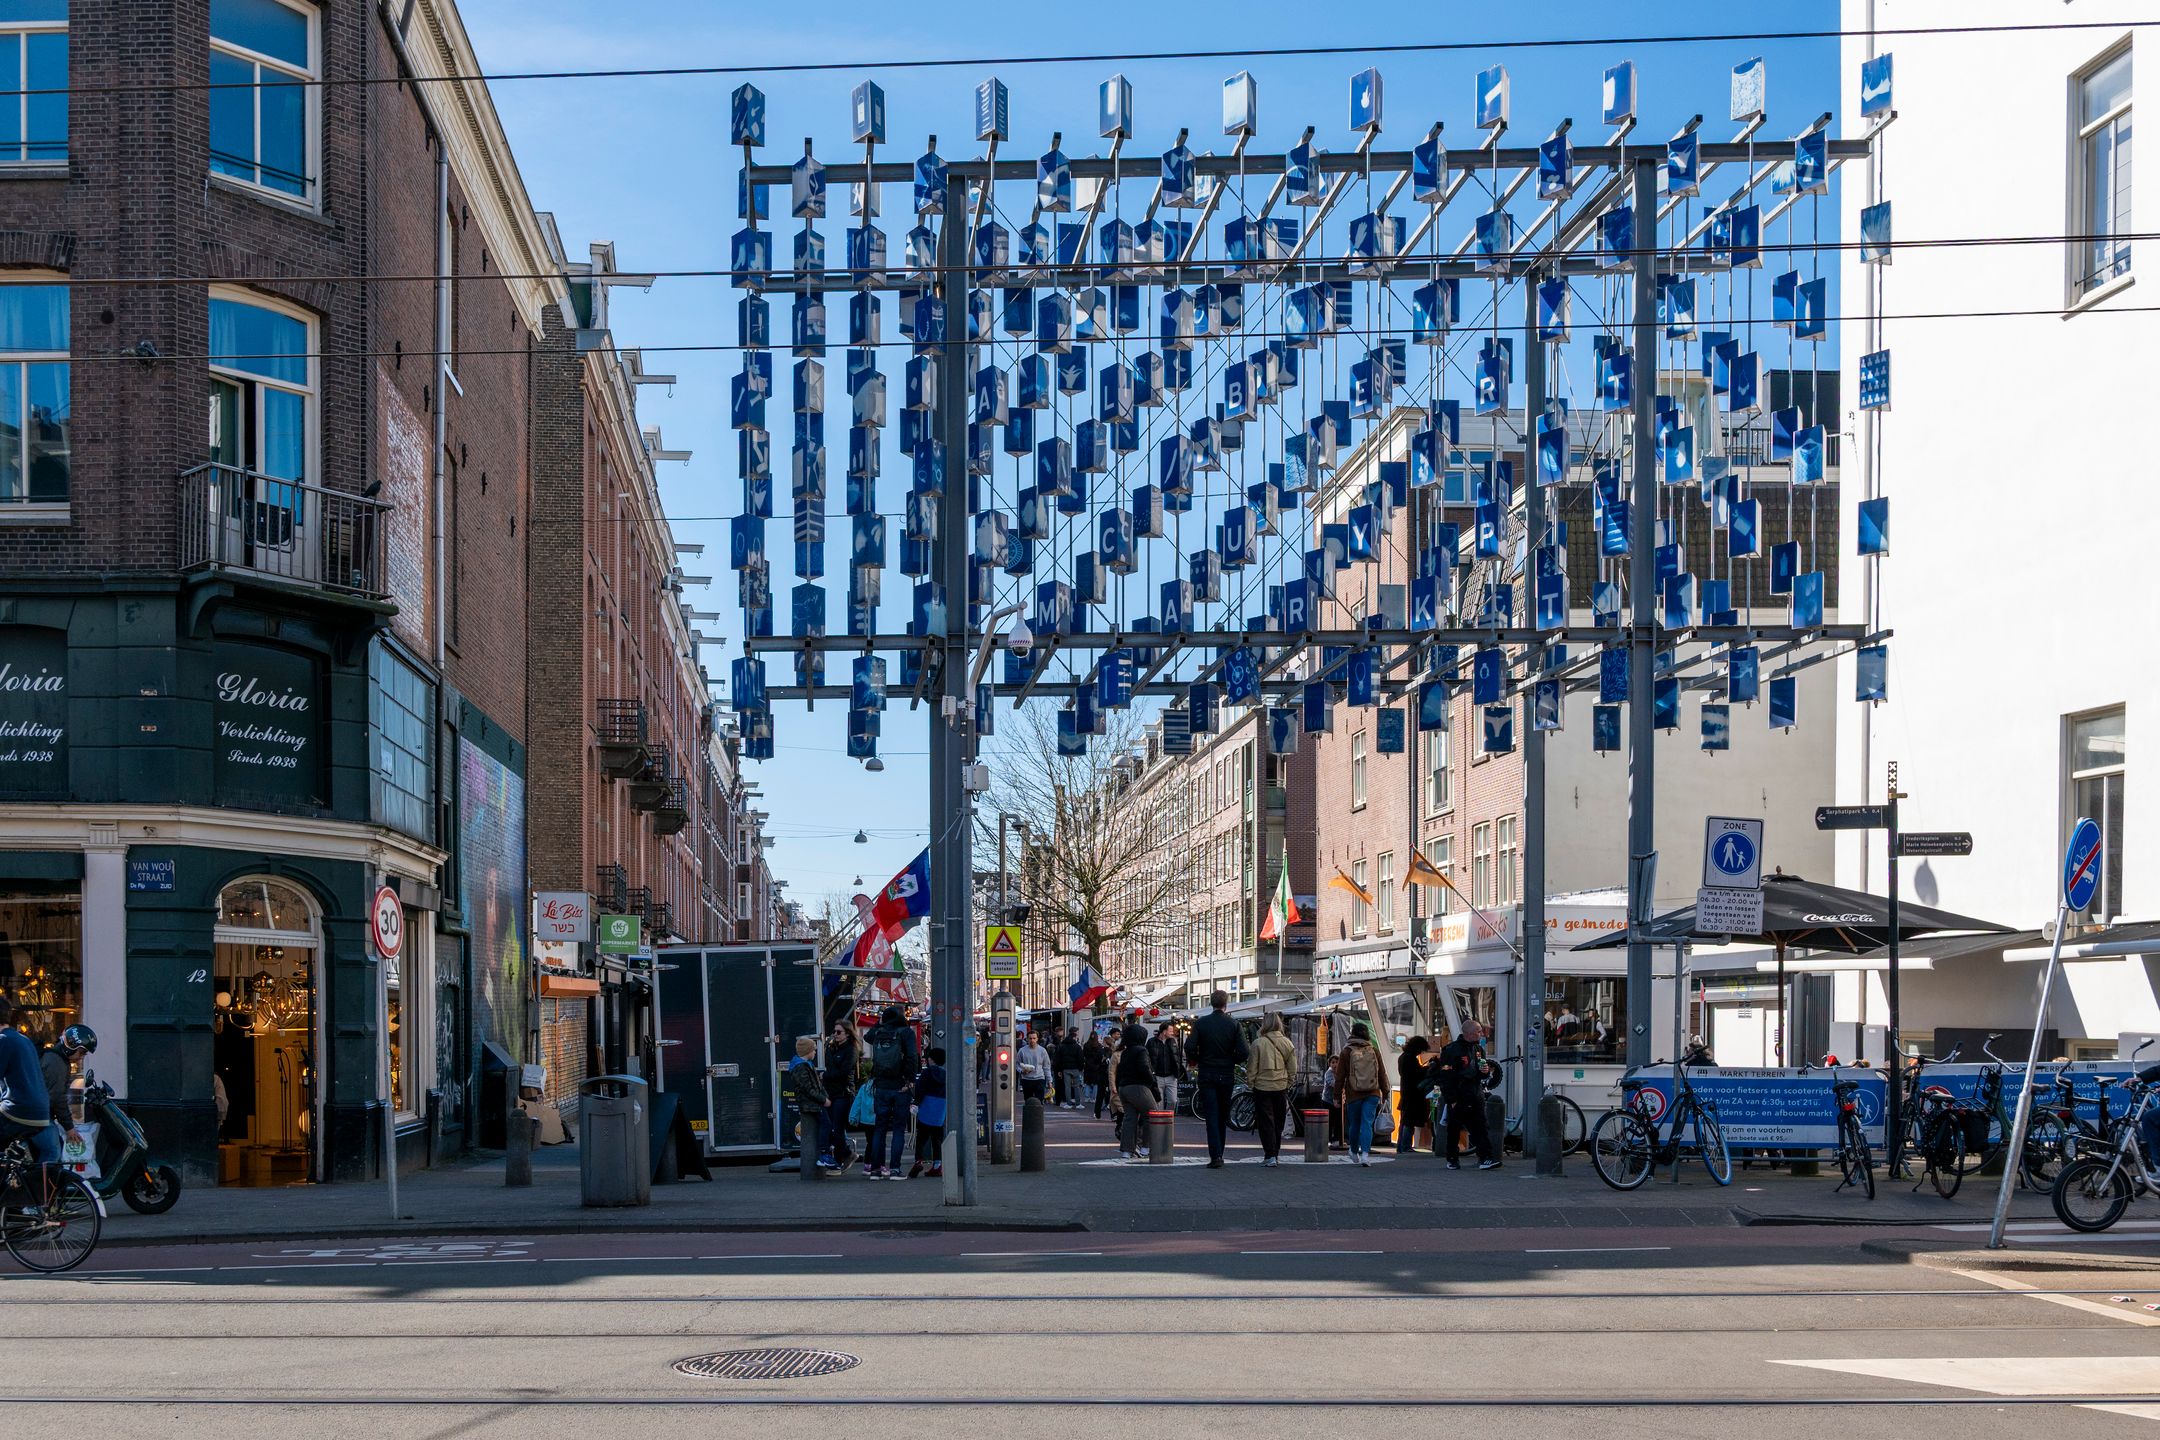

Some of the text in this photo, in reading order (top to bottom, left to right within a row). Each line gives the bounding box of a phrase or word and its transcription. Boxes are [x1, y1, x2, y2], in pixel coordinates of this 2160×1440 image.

[0, 664, 64, 692] loria
[217, 672, 309, 711] Gloria
[0, 721, 63, 744] lichting
[218, 721, 307, 751] Verlichting
[0, 750, 54, 763] nds 1938
[227, 749, 298, 768] Sinds 1938
[1723, 822, 1747, 830] ZONE
[132, 862, 172, 871] VAN WOU
[137, 873, 166, 882] STRAAT
[560, 904, 584, 919] Biss
[380, 910, 398, 936] 30
[1802, 913, 1876, 923] Coca-Cola
[1430, 924, 1465, 944] PIETERSMA
[1413, 936, 1427, 946] AS
[186, 968, 207, 984] 12
[1720, 1070, 1748, 1078] MARKT
[1737, 1086, 1768, 1094] fietsers
[1784, 1087, 1834, 1096] scooterrijde
[1762, 1098, 1785, 1106] 6:30u
[1774, 1109, 1806, 1117] afbouw
[1720, 1126, 1730, 1134] Rij
[1758, 1126, 1794, 1134] voorkom
